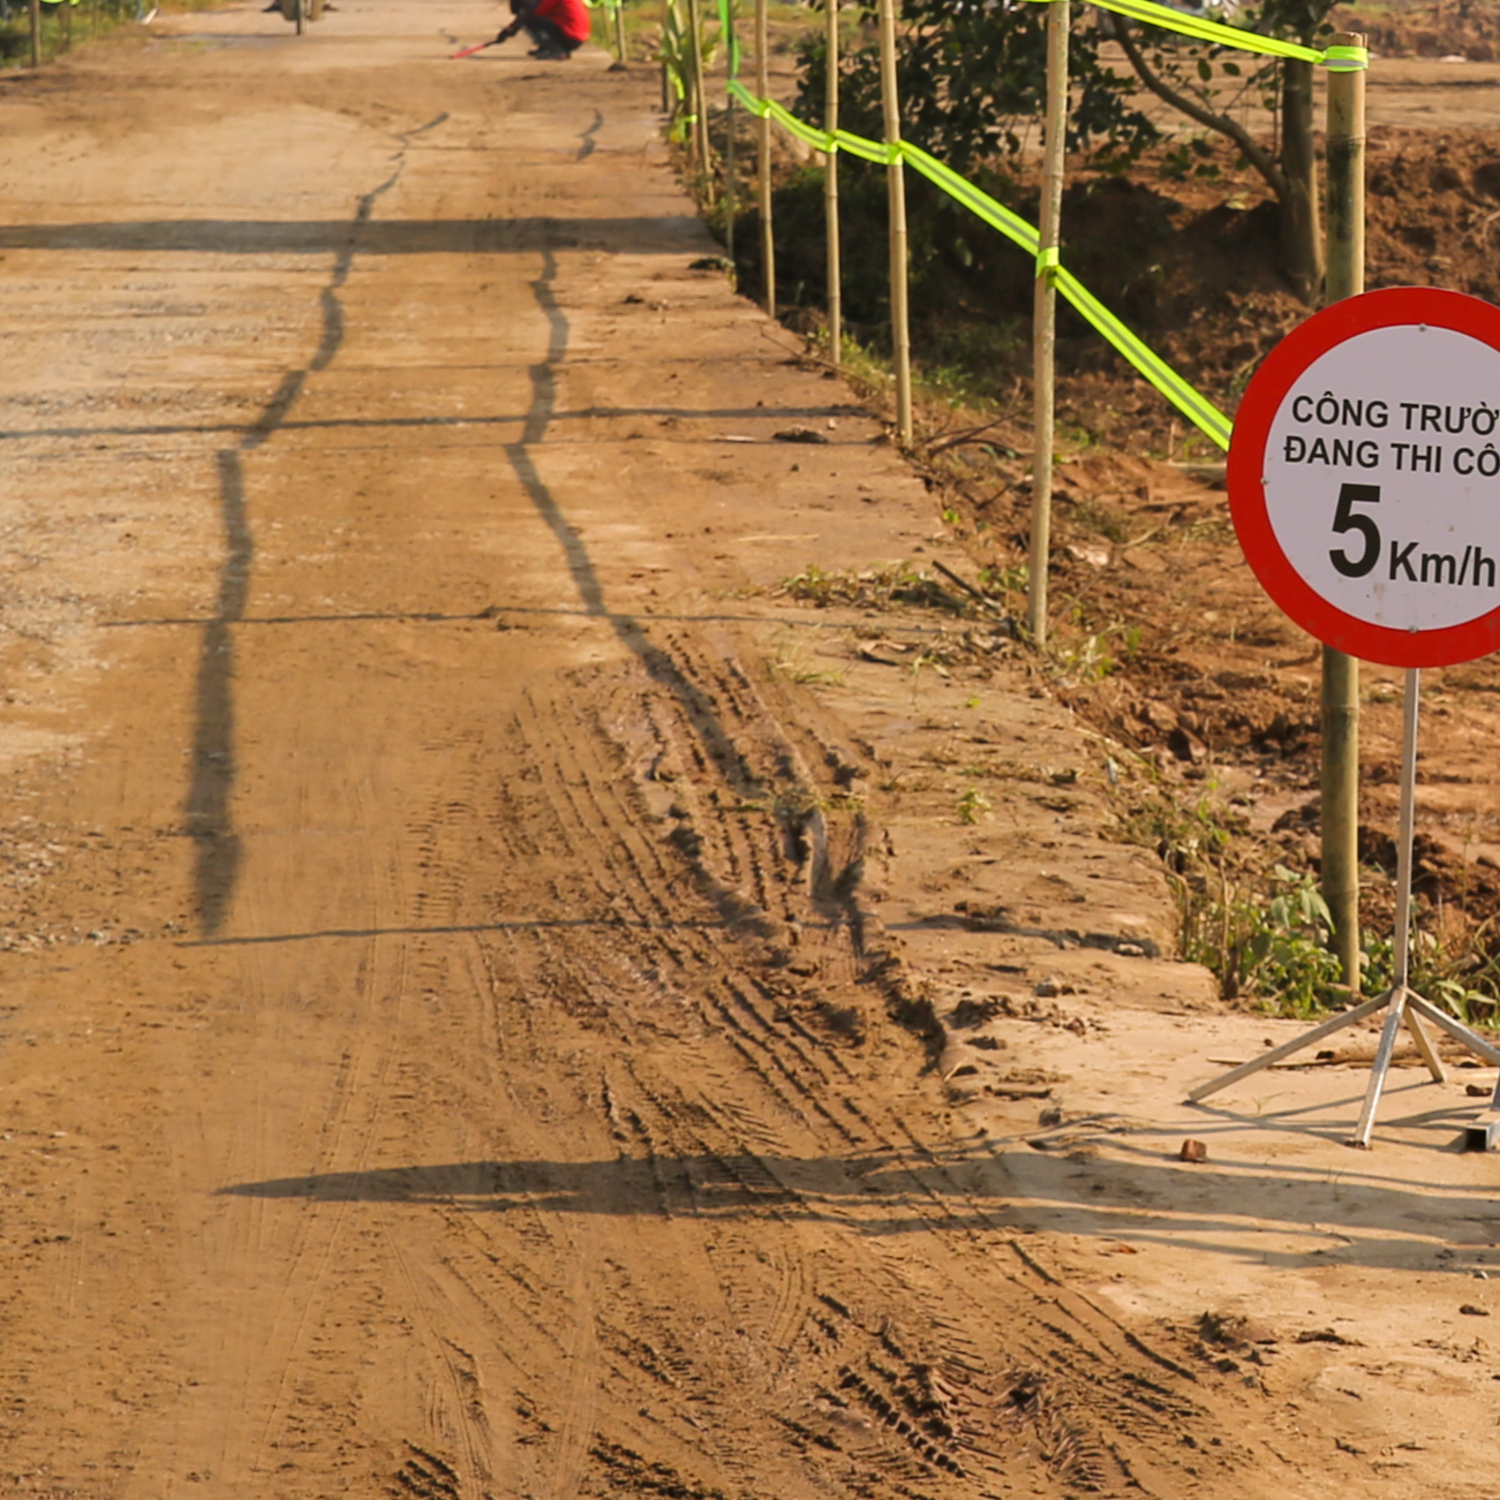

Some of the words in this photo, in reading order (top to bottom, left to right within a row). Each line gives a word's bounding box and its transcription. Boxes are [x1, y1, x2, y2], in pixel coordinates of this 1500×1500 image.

[1291, 390, 1390, 429] CÔNG
[1283, 435, 1380, 469] ĐANG
[1390, 442, 1443, 474] THI
[1328, 482, 1382, 579] 5
[1388, 539, 1497, 588] Km/h
